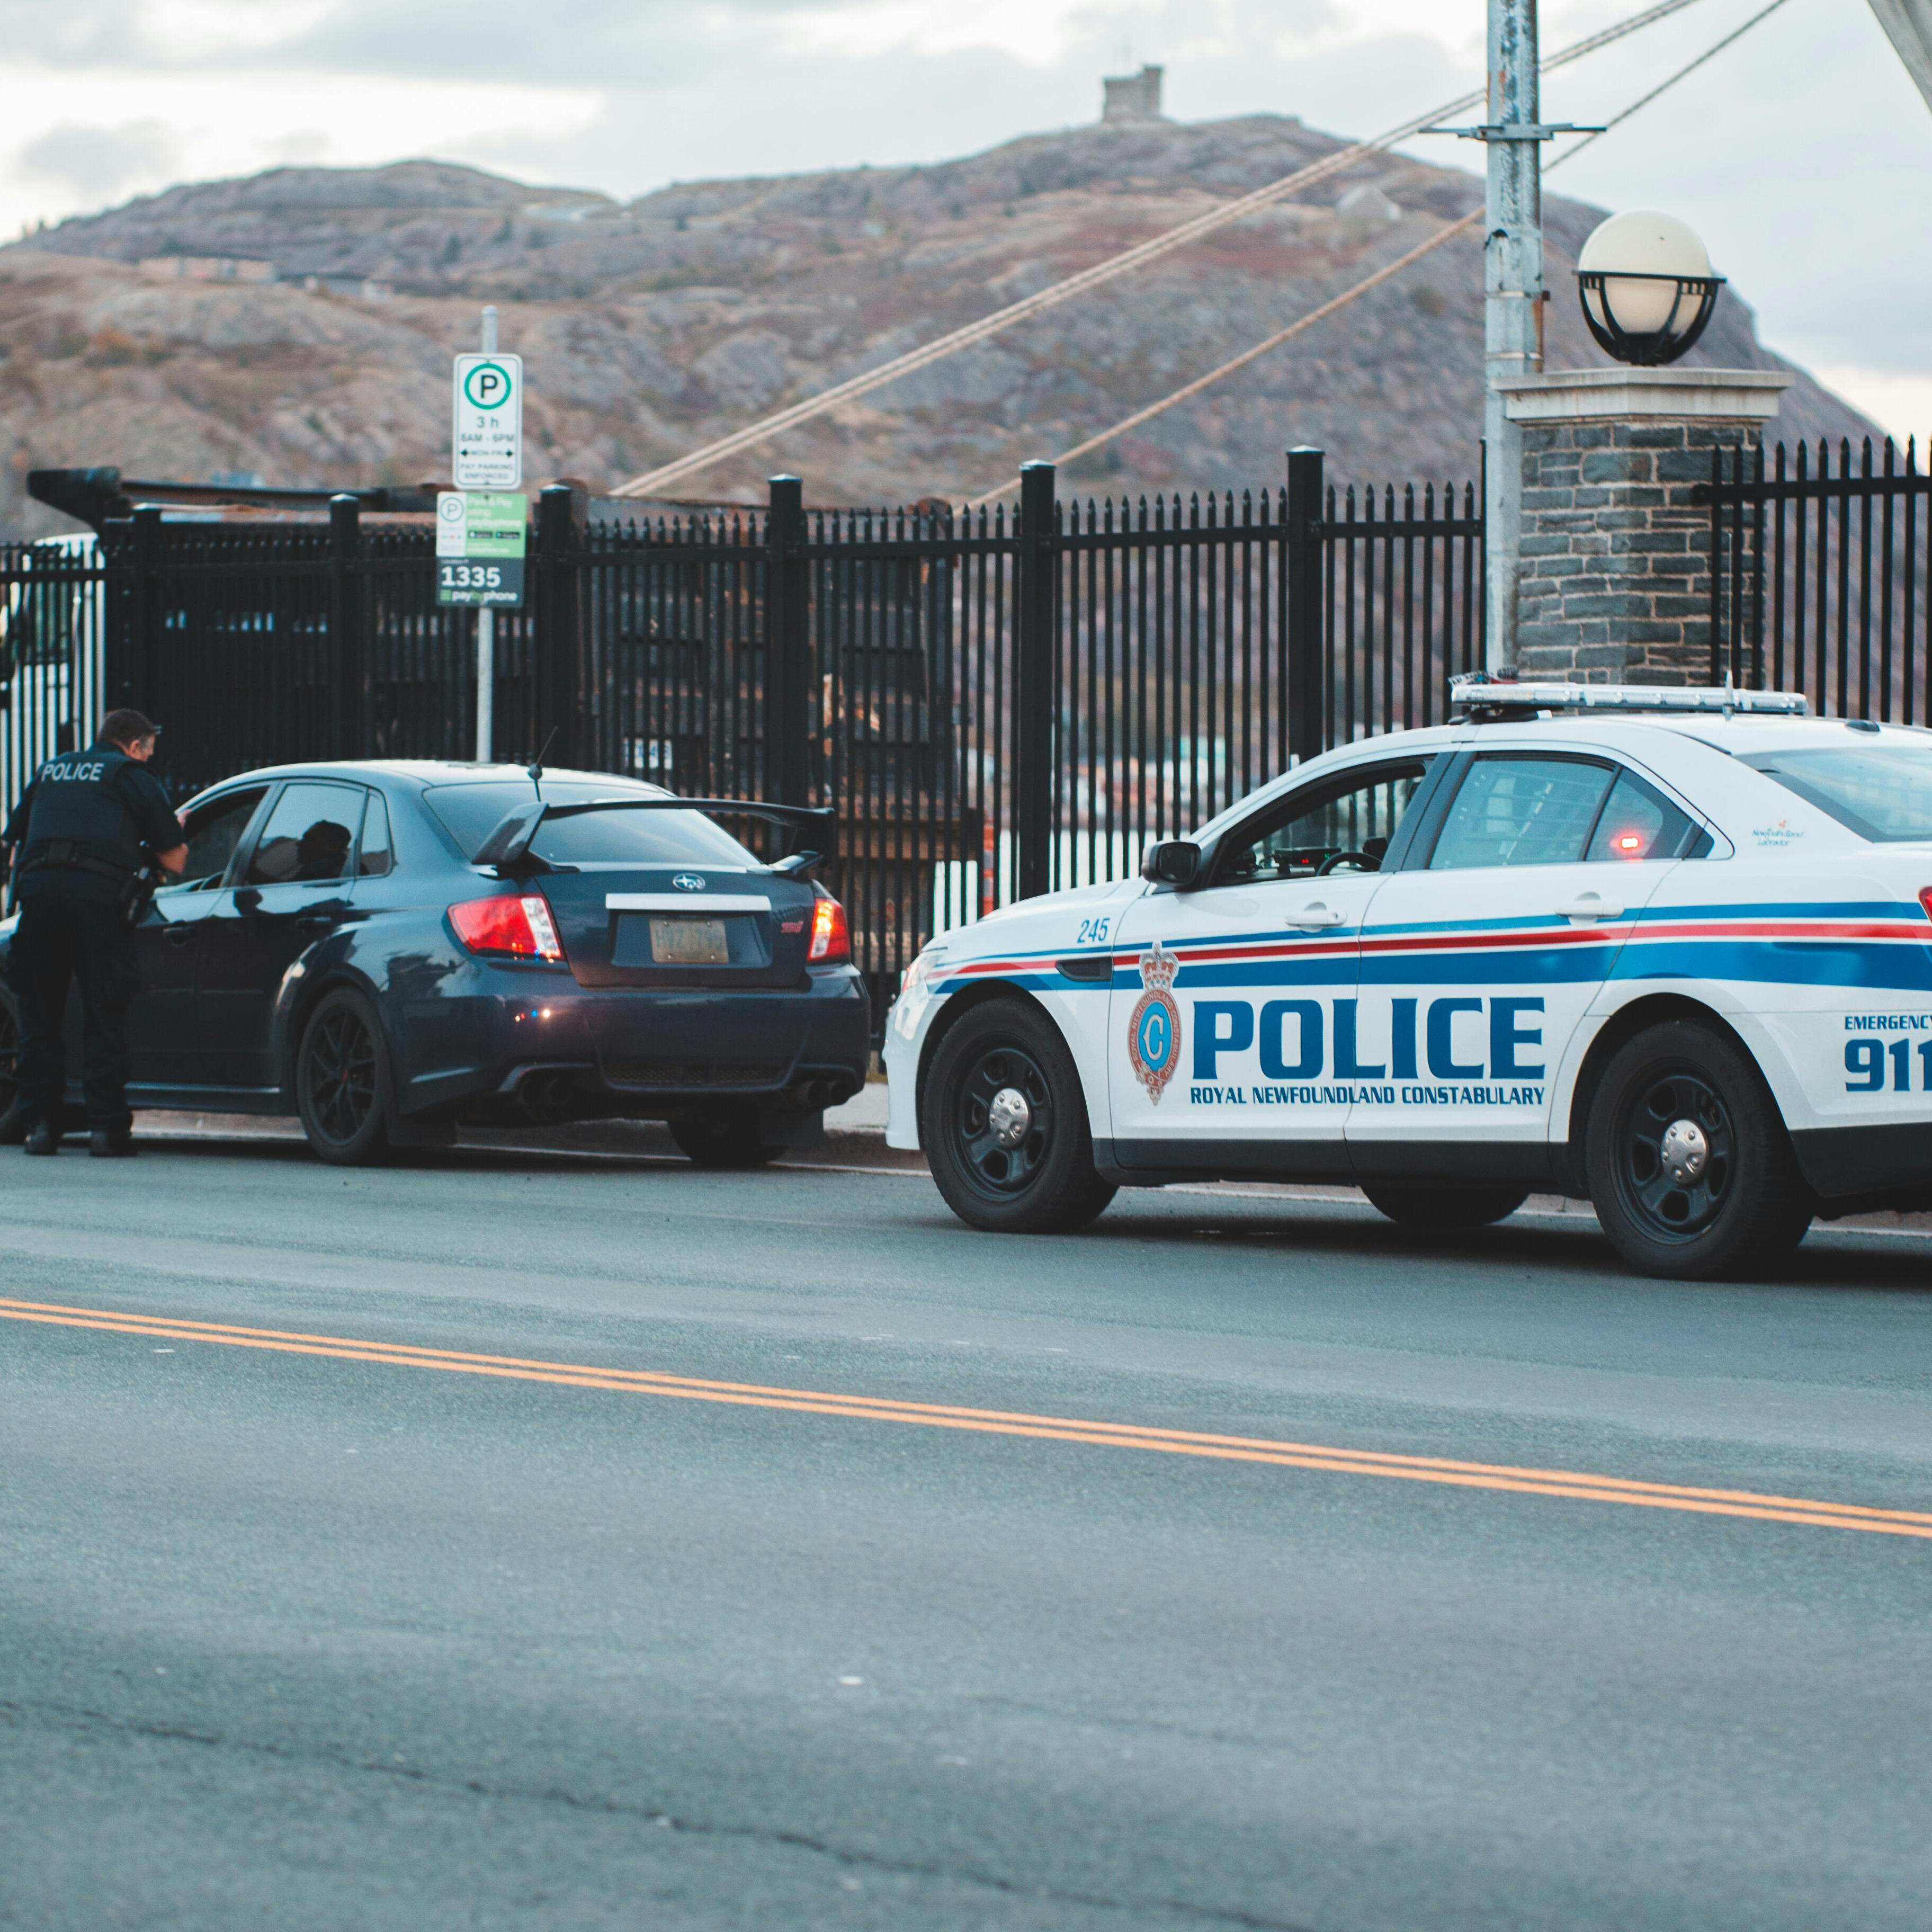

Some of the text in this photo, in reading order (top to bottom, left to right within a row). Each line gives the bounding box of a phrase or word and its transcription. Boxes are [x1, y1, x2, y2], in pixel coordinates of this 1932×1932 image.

[481, 374, 498, 398] P
[477, 416, 498, 428] 3 h
[461, 433, 482, 442] 8AM
[493, 433, 514, 442] 6PM
[447, 504, 458, 516] P
[441, 566, 501, 587] 1335
[41, 763, 104, 782] POLICE
[1077, 917, 1110, 943] 245
[1845, 1015, 1932, 1030] EMERGENC
[1142, 1014, 1164, 1060] C
[1193, 997, 1545, 1080] POLICE
[1845, 1038, 1932, 1092] 911
[1190, 1086, 1545, 1105] ROYAL NEWFOUNDLAND CONSTABULARY
